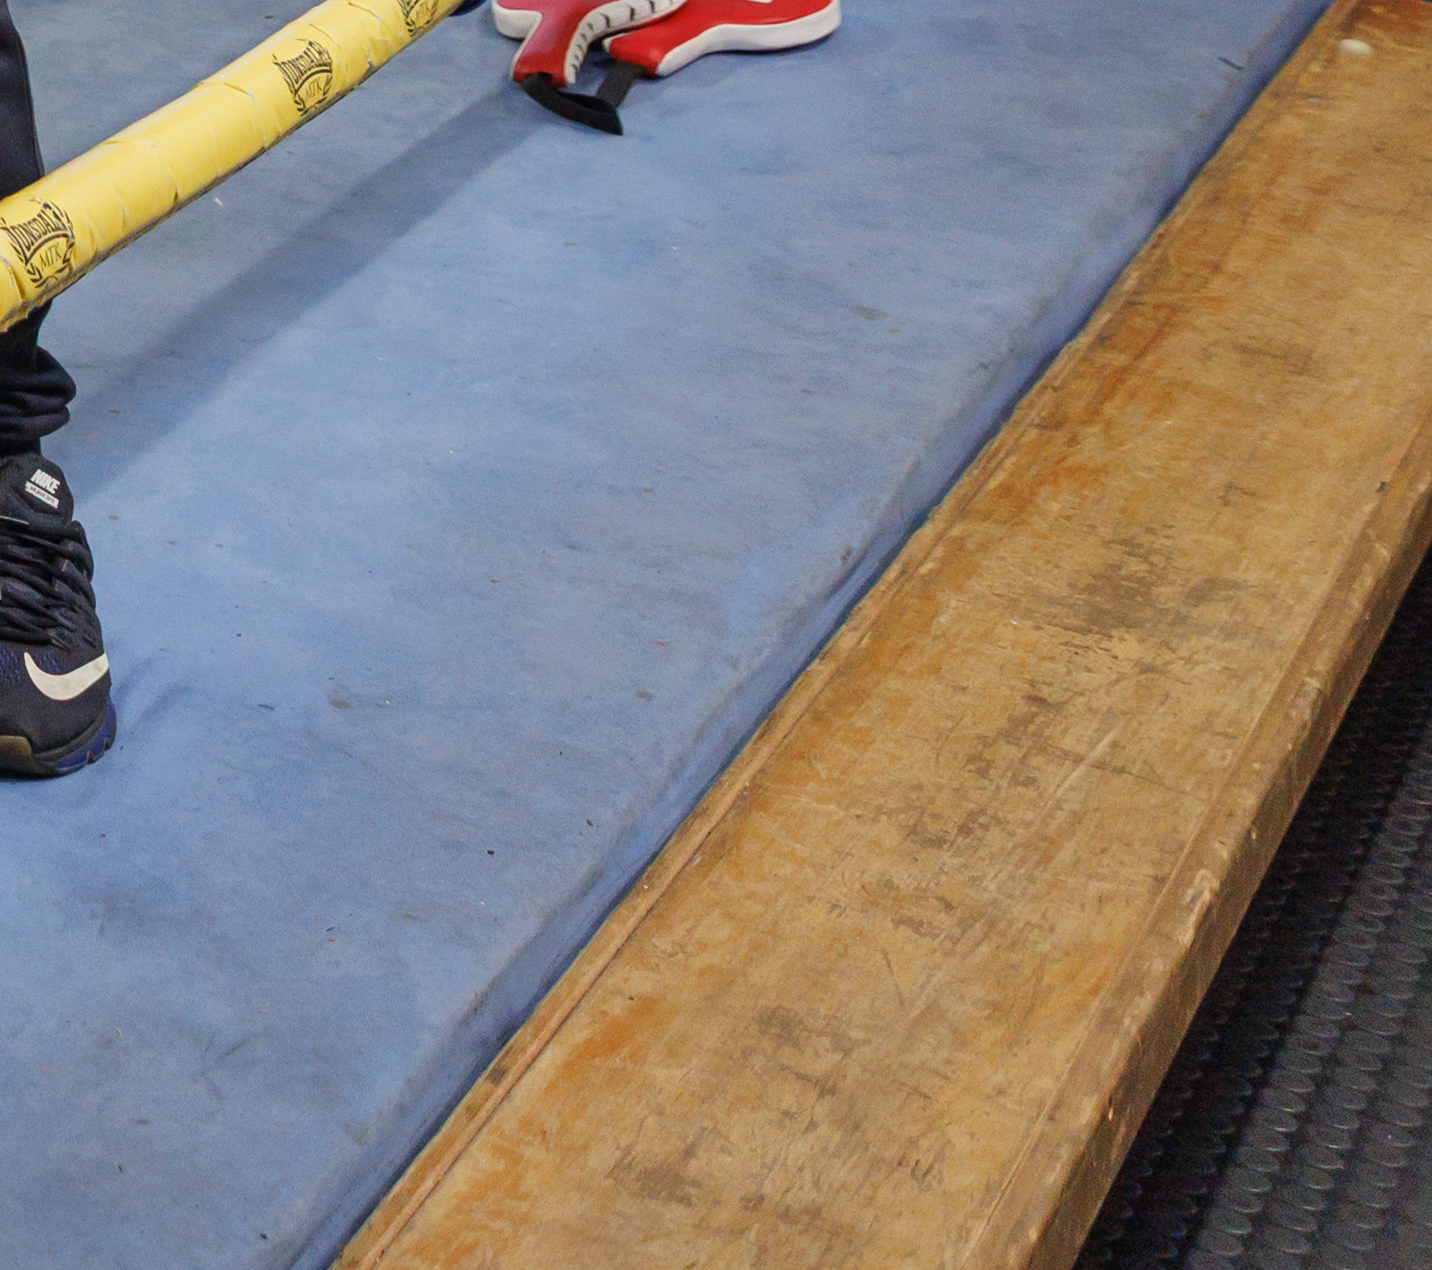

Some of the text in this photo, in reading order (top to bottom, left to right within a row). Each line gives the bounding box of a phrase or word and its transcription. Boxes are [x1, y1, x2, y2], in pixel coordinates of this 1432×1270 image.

[273, 41, 333, 96] LONSDALE
[304, 75, 325, 100] MTK
[1, 201, 73, 266] LONSDALE
[38, 240, 64, 269] MTK
[30, 468, 61, 495] NIKE
